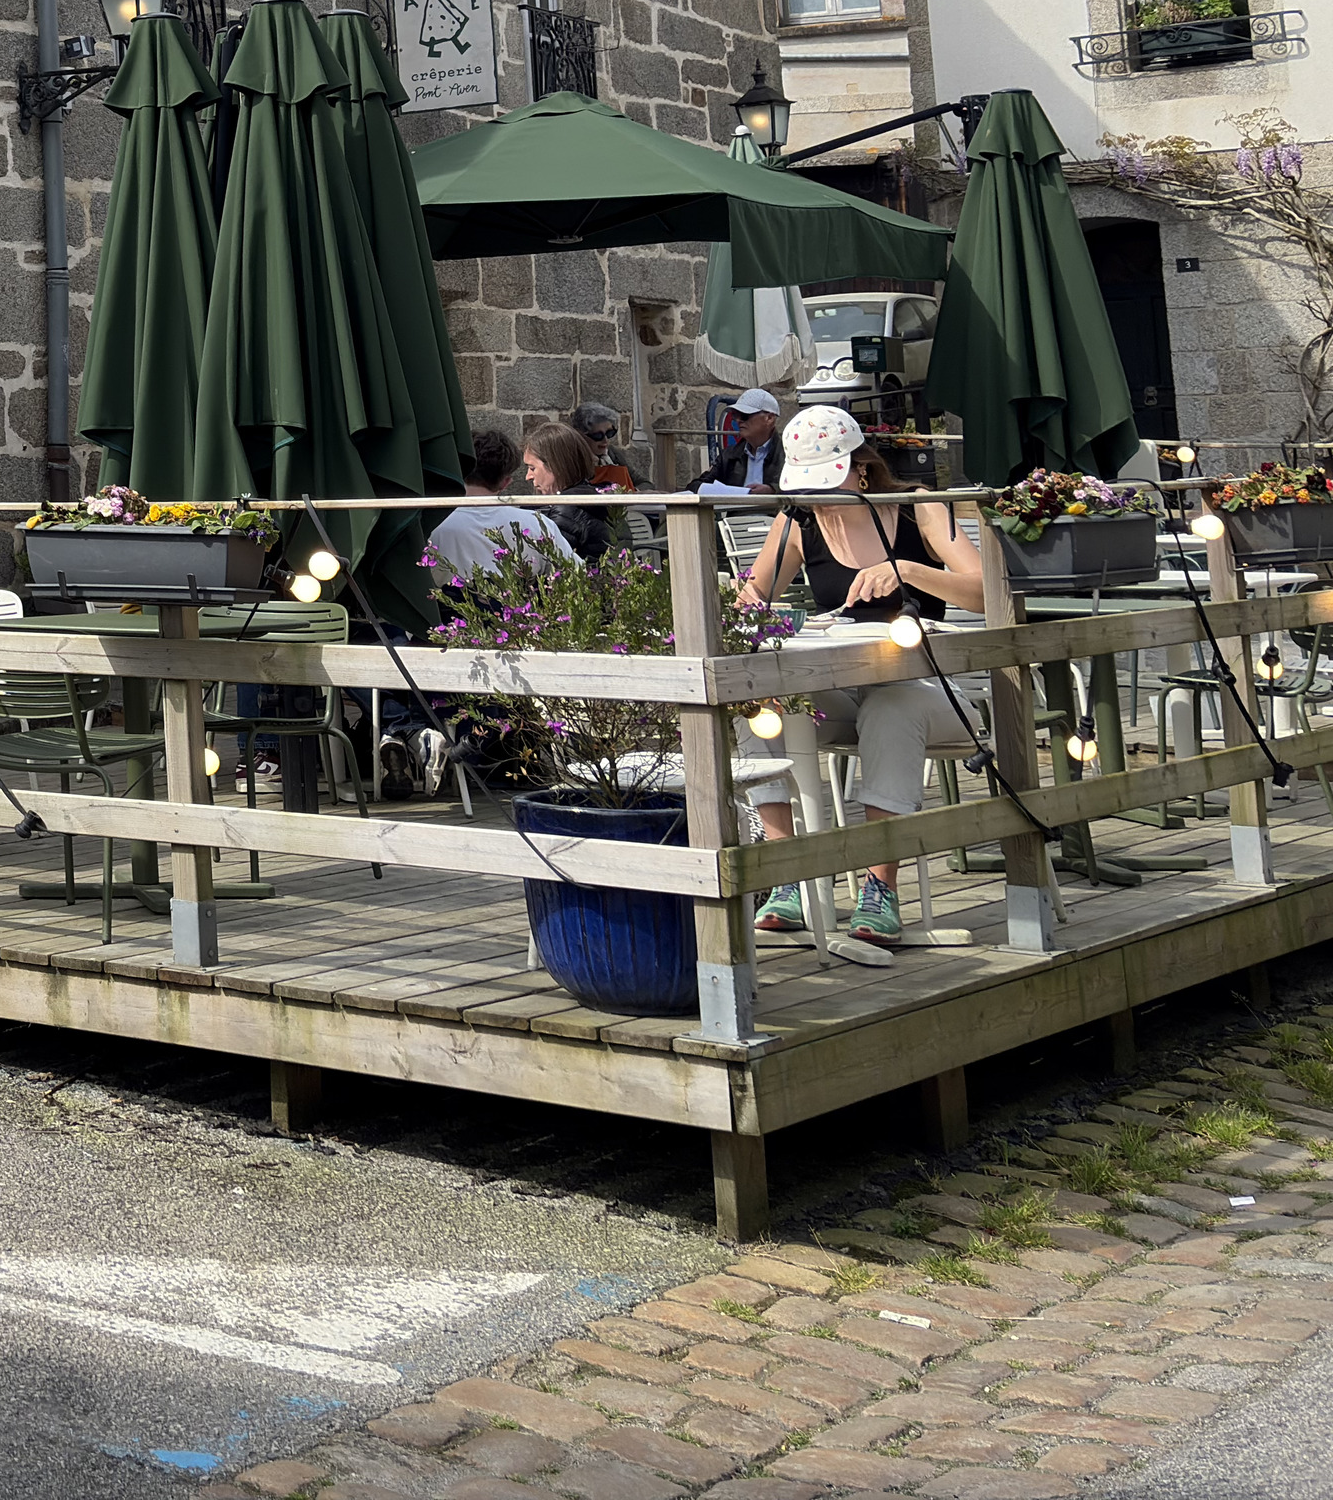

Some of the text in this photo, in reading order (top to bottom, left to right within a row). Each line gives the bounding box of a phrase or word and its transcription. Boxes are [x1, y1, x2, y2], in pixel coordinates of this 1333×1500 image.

[411, 64, 483, 82] crêperie
[414, 82, 481, 102] Pont-Aven
[1184, 260, 1192, 269] 3
